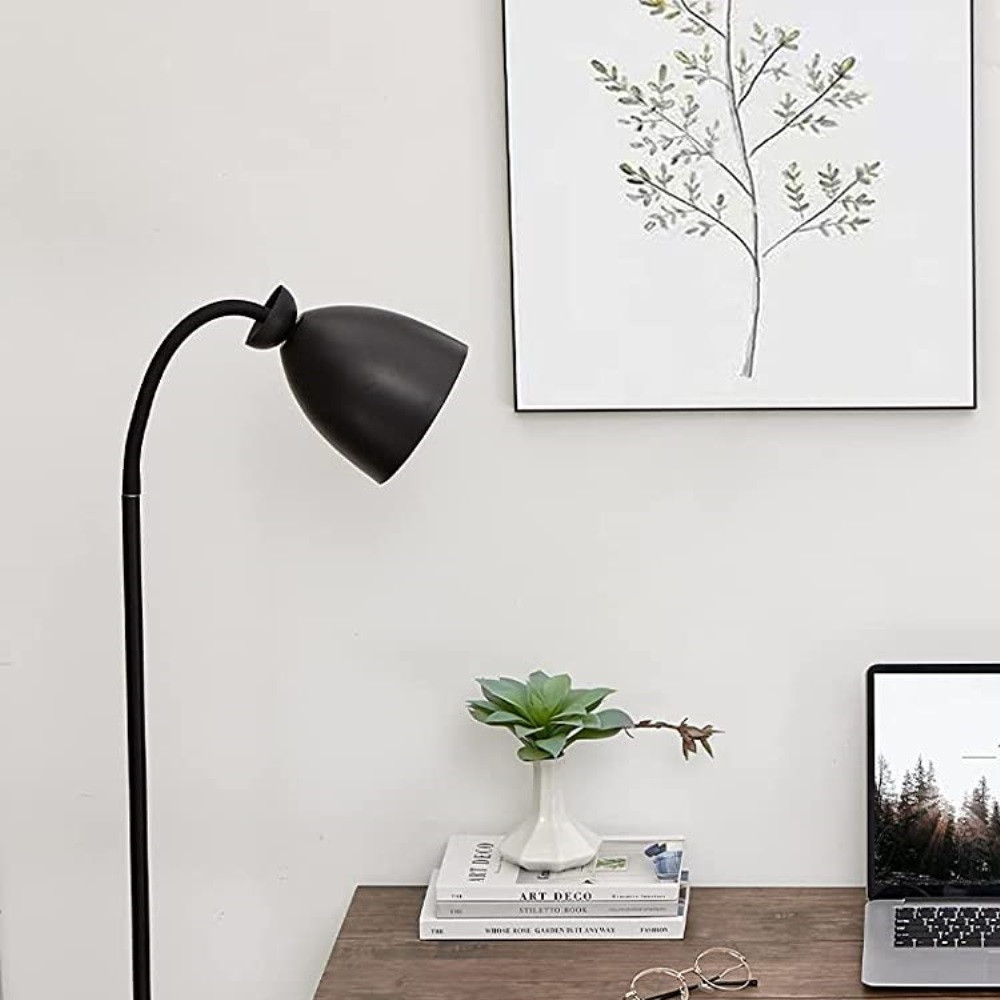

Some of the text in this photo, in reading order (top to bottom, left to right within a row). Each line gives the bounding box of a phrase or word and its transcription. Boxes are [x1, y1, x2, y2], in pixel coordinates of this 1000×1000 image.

[468, 842, 494, 881] ART DECO
[519, 892, 592, 901] ART DECO
